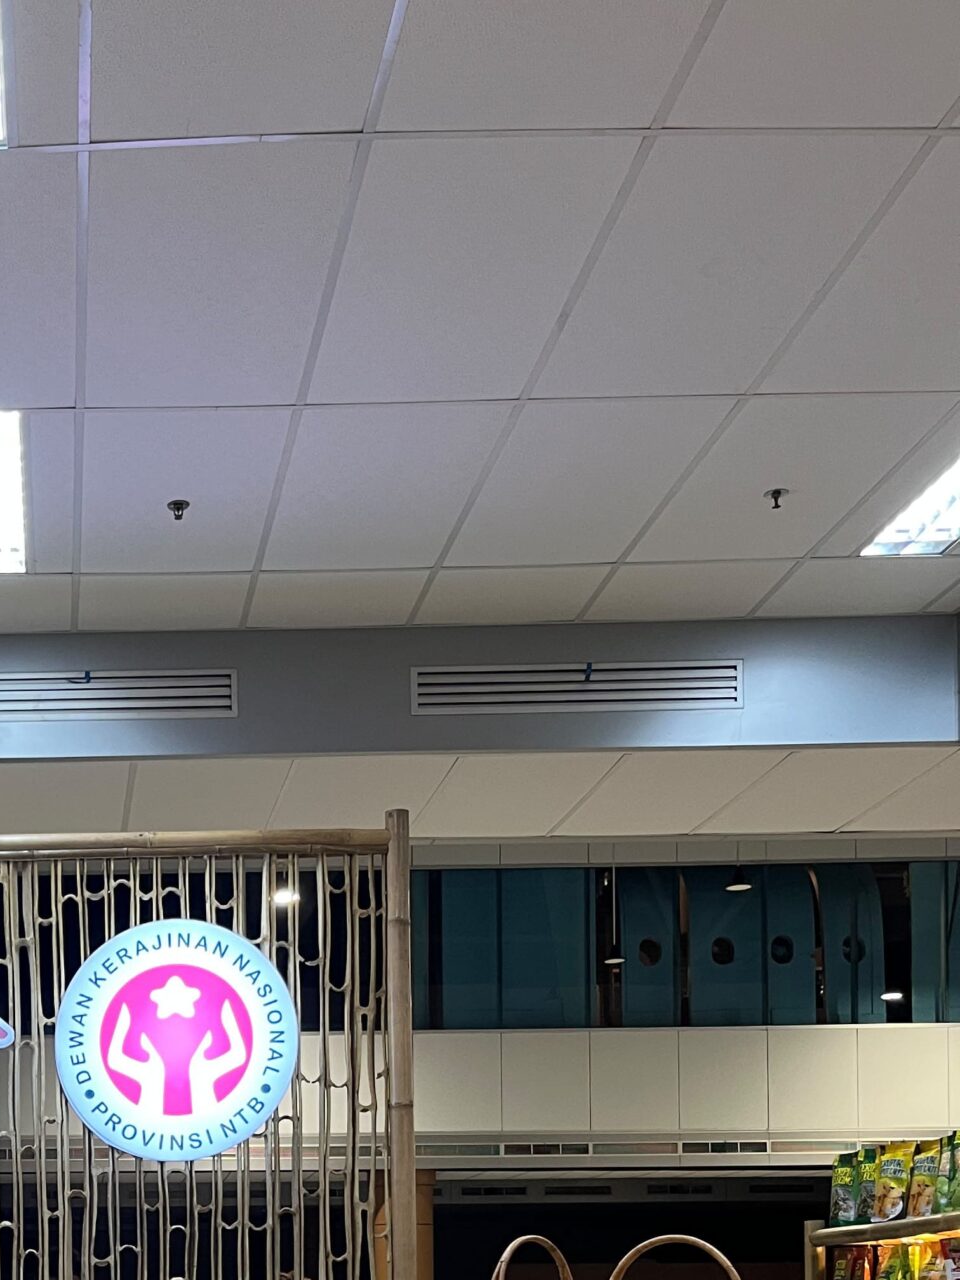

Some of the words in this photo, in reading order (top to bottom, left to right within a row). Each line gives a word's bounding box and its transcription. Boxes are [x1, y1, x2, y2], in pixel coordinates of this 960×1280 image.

[68, 993, 93, 1085] DEWAN
[89, 932, 230, 989] KERAJINAN
[232, 953, 285, 1077] NASIONAL
[91, 1100, 214, 1151] PROVINSI
[219, 1096, 266, 1139] NTB
